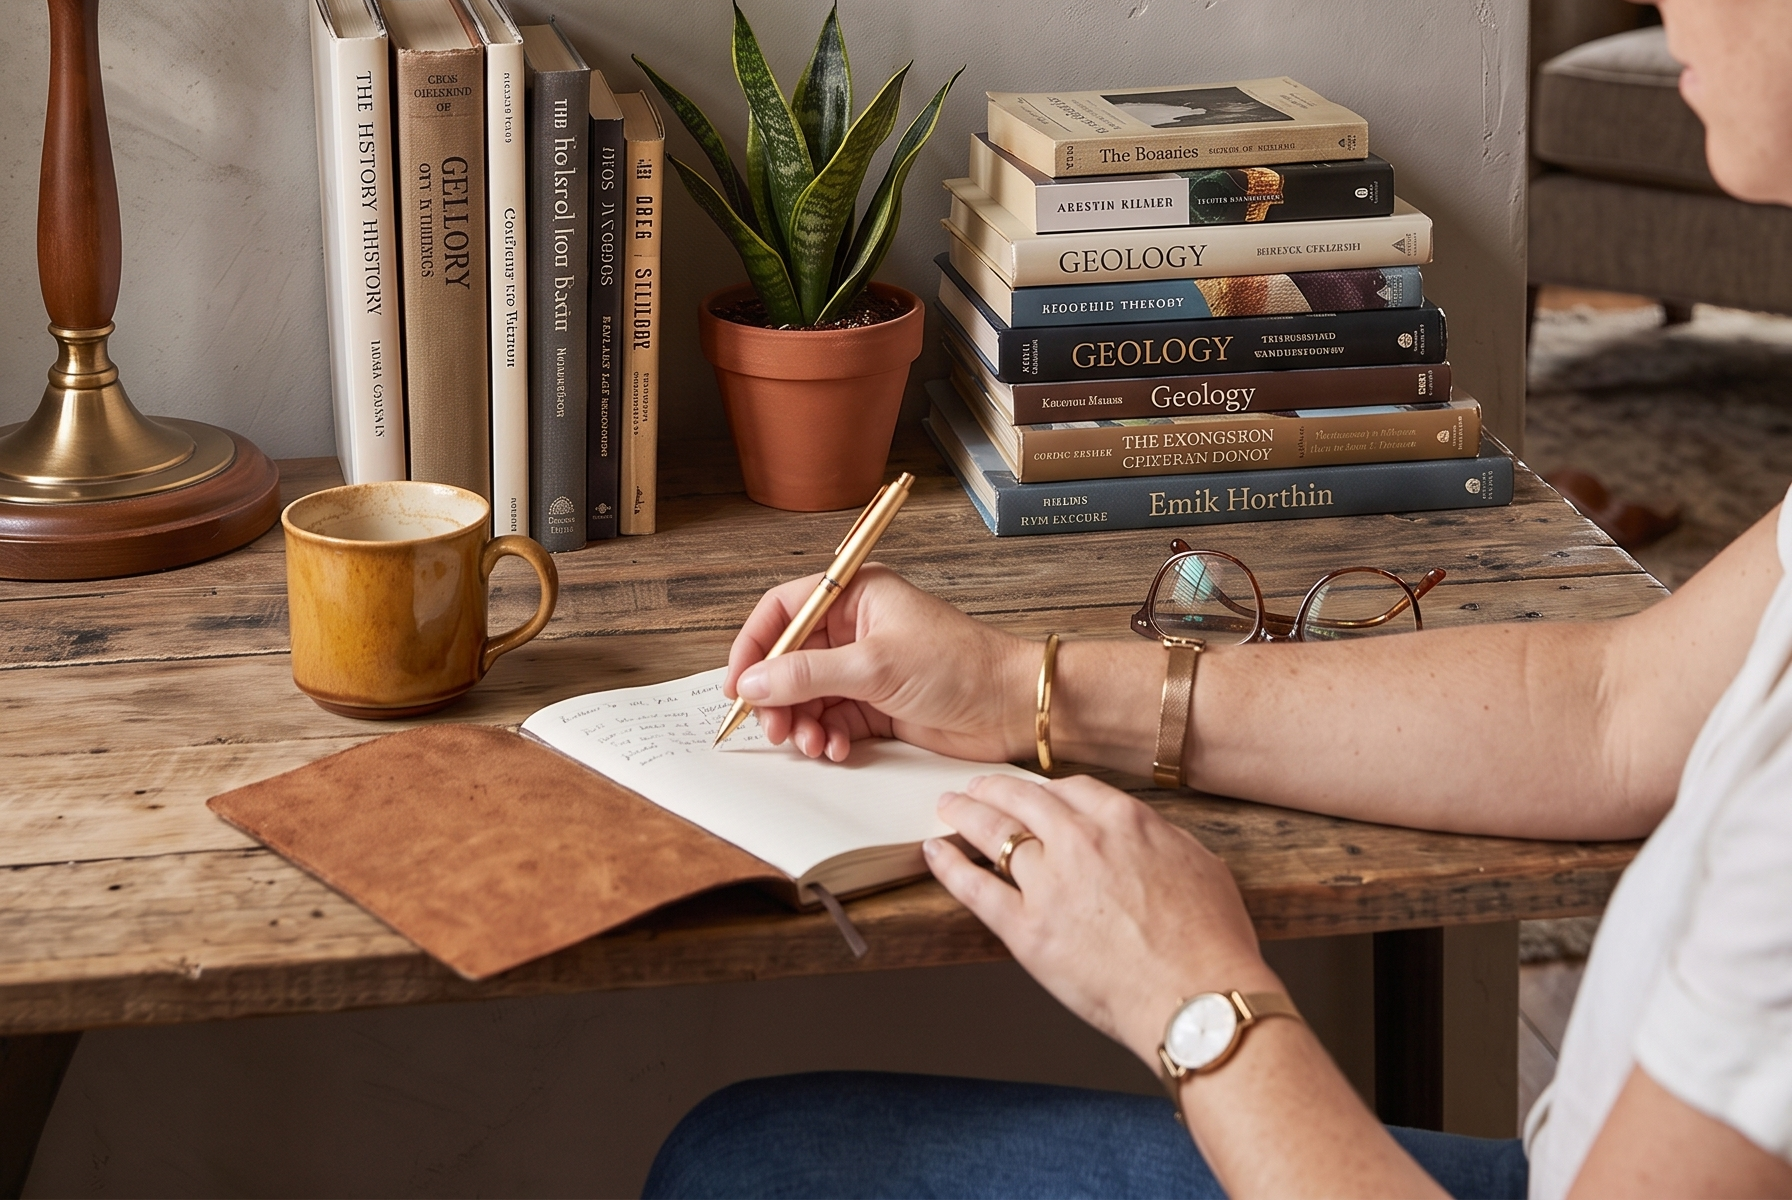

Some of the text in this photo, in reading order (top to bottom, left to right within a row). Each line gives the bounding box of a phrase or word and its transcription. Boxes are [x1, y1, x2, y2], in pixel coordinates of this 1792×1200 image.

[356, 70, 373, 112] THE
[1099, 147, 1131, 163] The
[1057, 200, 1115, 213] ARESTIN
[1059, 244, 1208, 274] GEOLOGY
[1071, 336, 1234, 369] GEOLOGY
[1151, 381, 1257, 412] Geology
[1122, 434, 1160, 450] THE
[1212, 447, 1273, 464] DONOY
[1149, 483, 1335, 517] Emik Horthin
